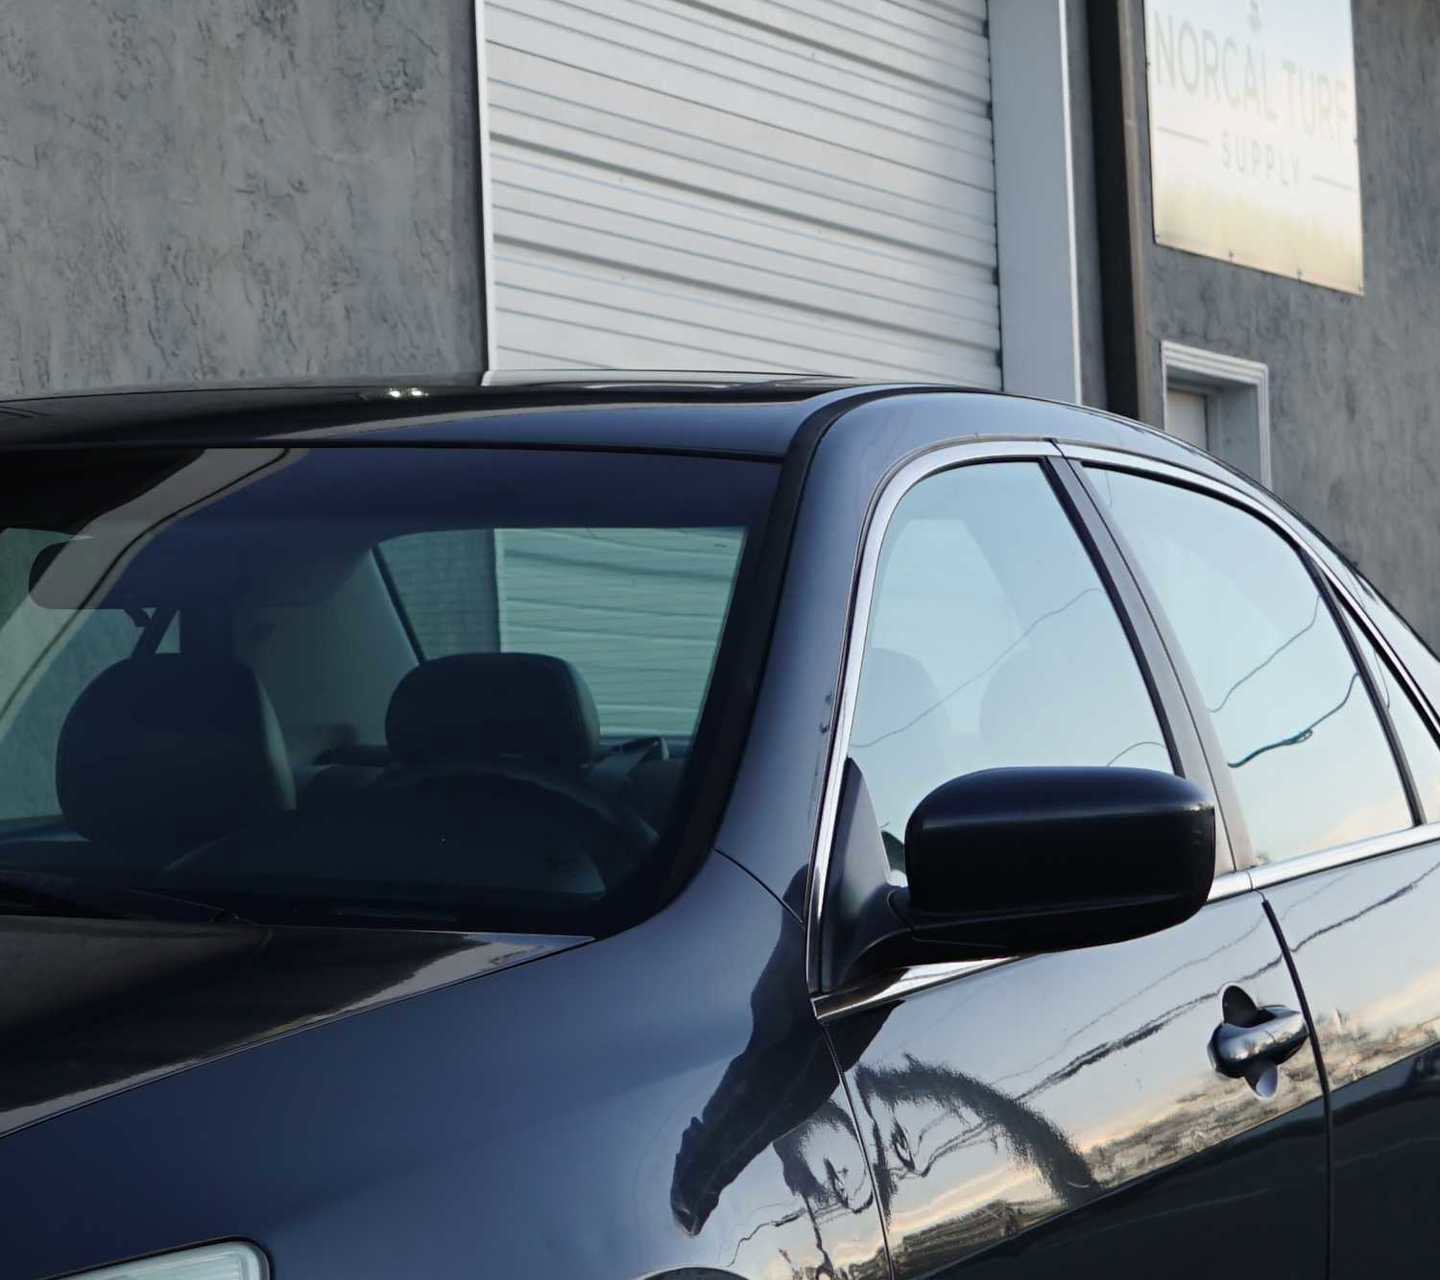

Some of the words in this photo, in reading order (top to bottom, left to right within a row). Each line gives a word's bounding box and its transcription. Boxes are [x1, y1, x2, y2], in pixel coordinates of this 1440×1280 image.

[1153, 11, 1279, 120] NORCAL
[1281, 61, 1349, 142] TURF
[1222, 133, 1302, 187] SUPPLY
